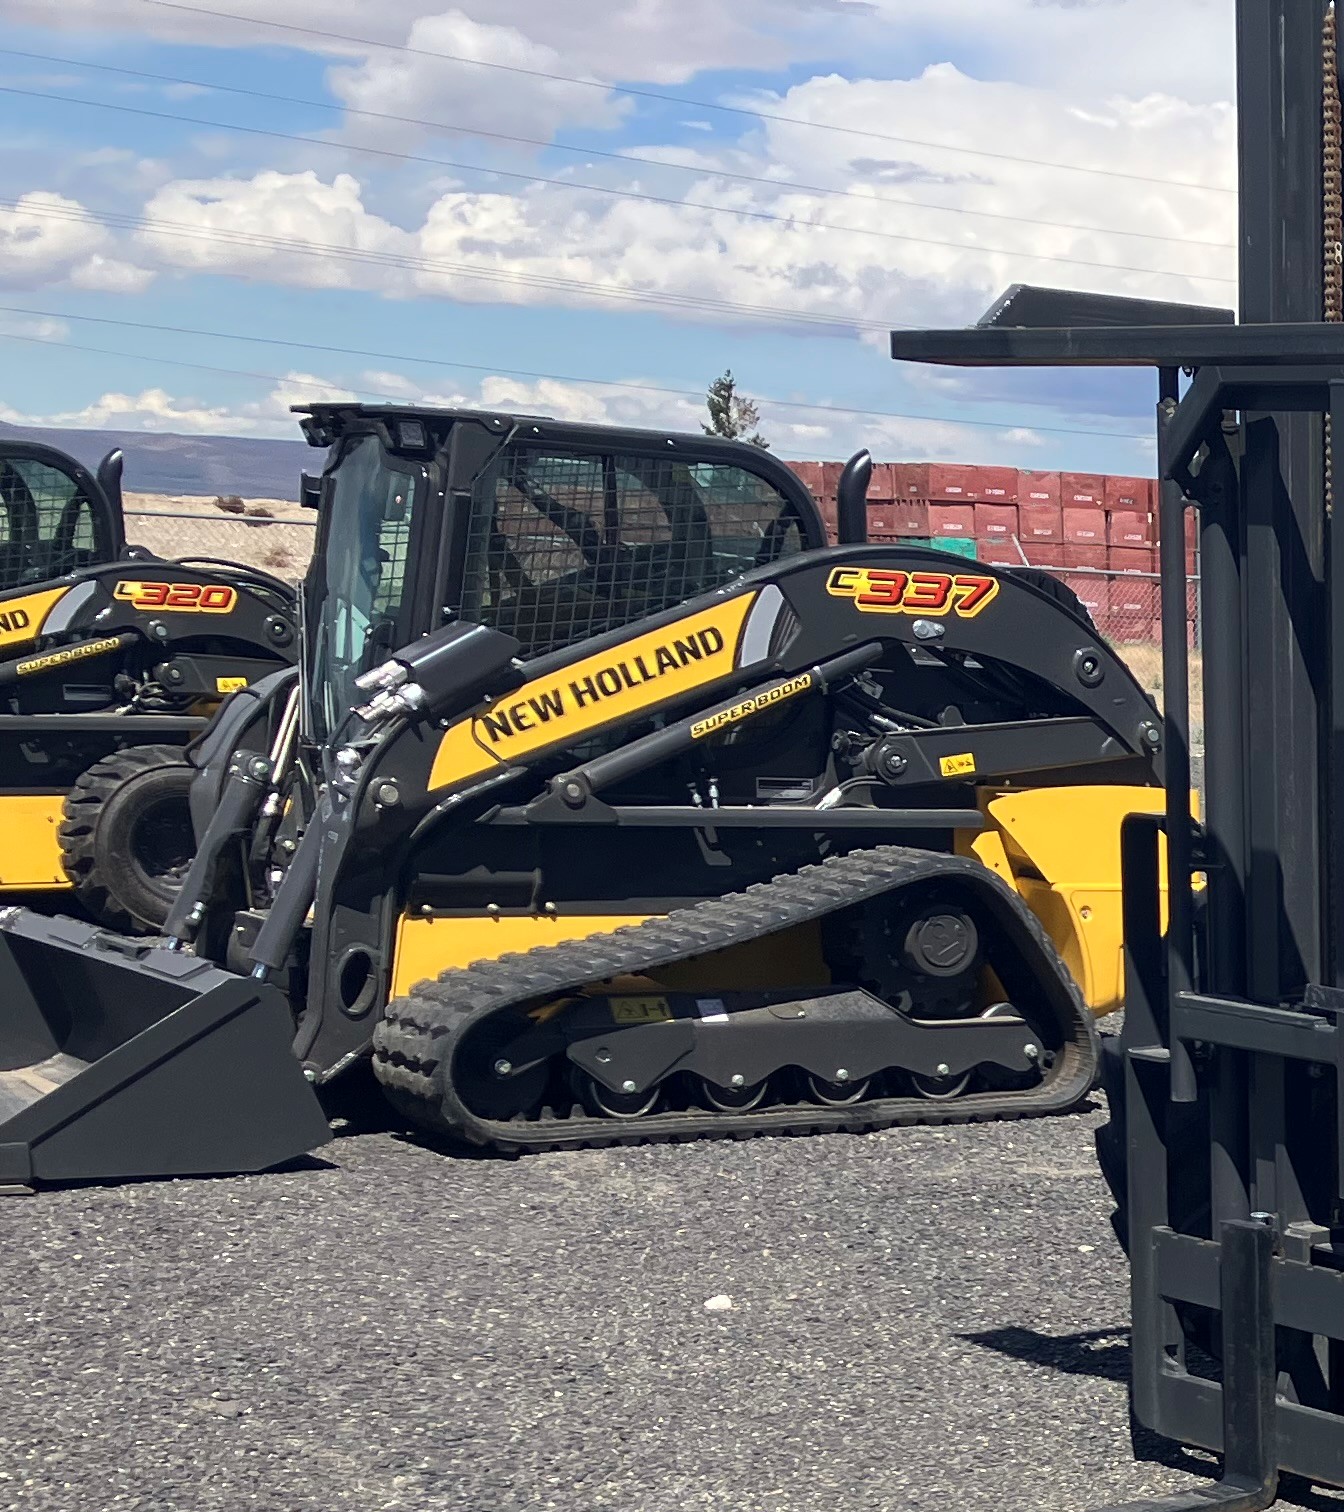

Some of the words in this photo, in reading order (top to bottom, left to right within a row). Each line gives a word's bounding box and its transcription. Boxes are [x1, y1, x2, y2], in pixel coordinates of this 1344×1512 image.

[116, 582, 235, 610] L320
[828, 568, 997, 611] C337
[484, 688, 565, 742] NEW
[569, 626, 724, 708] HOLLAND
